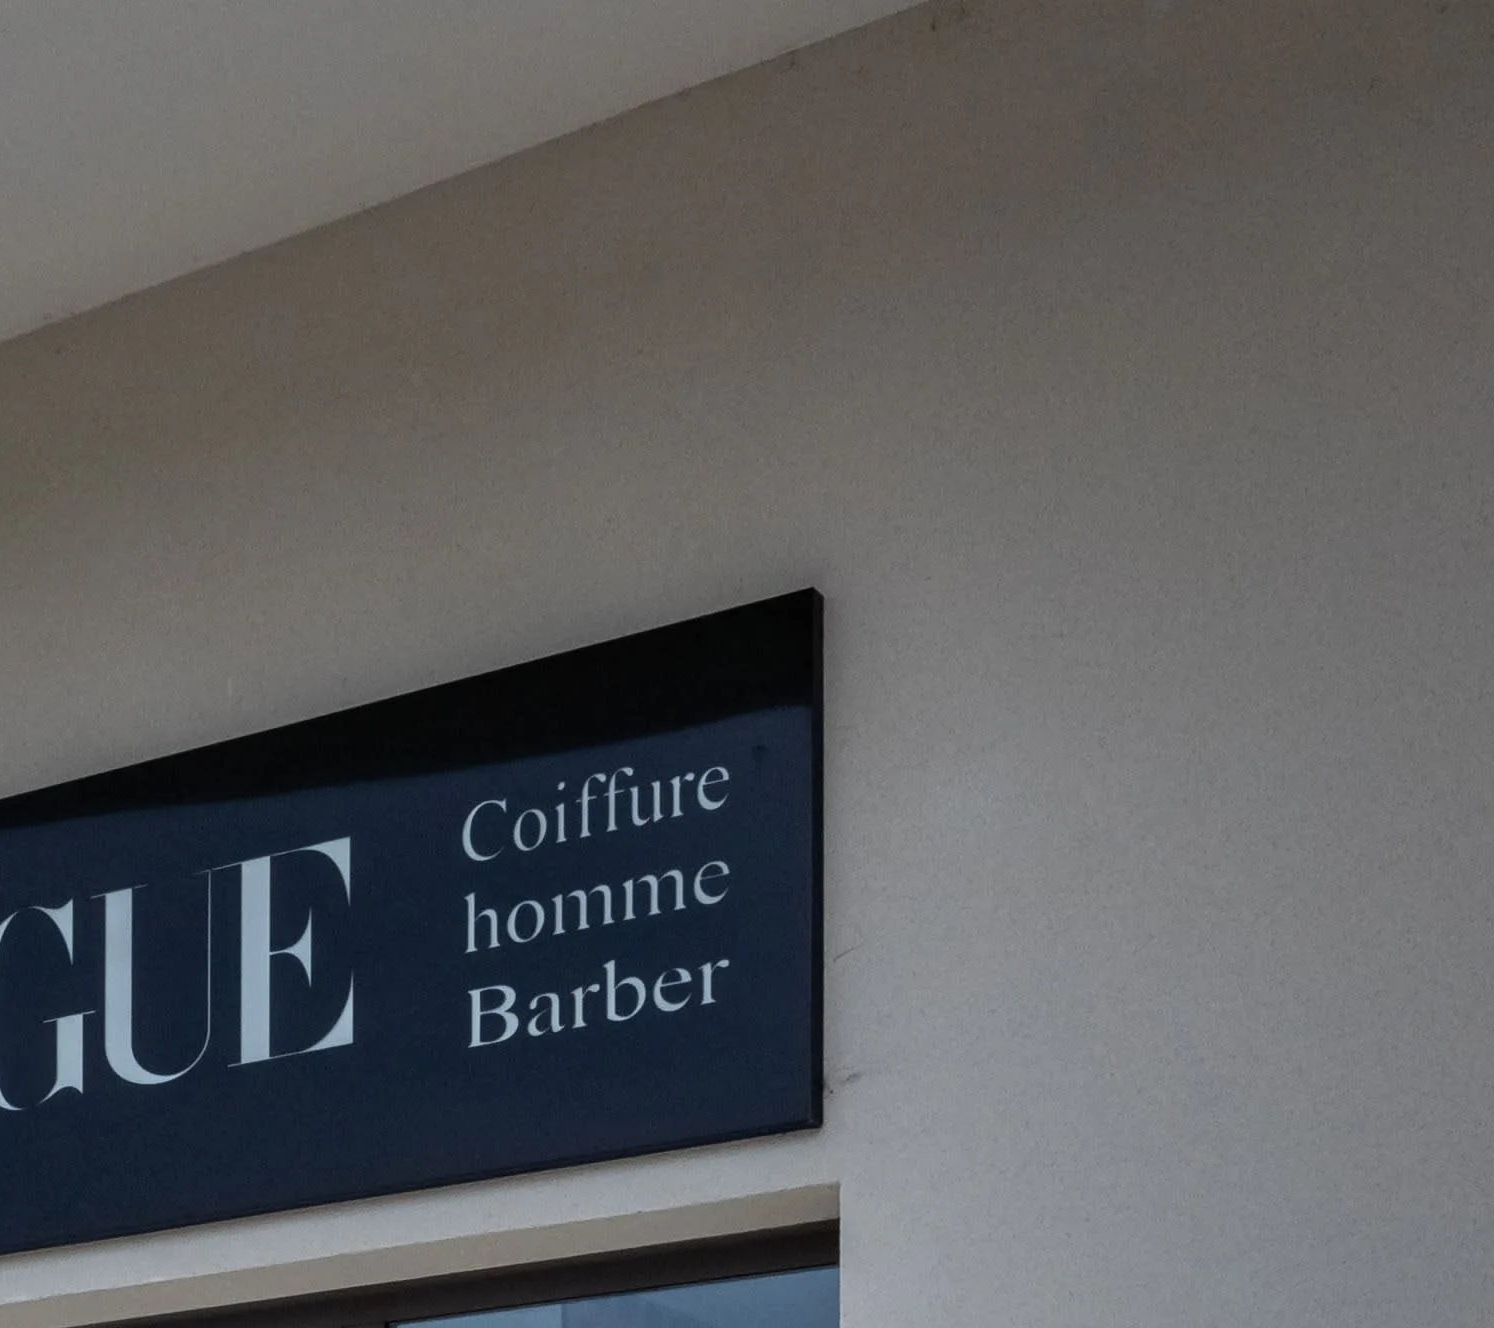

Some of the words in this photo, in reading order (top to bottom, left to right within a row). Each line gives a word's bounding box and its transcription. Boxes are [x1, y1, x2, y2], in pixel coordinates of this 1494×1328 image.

[462, 765, 730, 862] Coiffure
[464, 858, 730, 953] homme
[466, 956, 730, 1048] Barber
